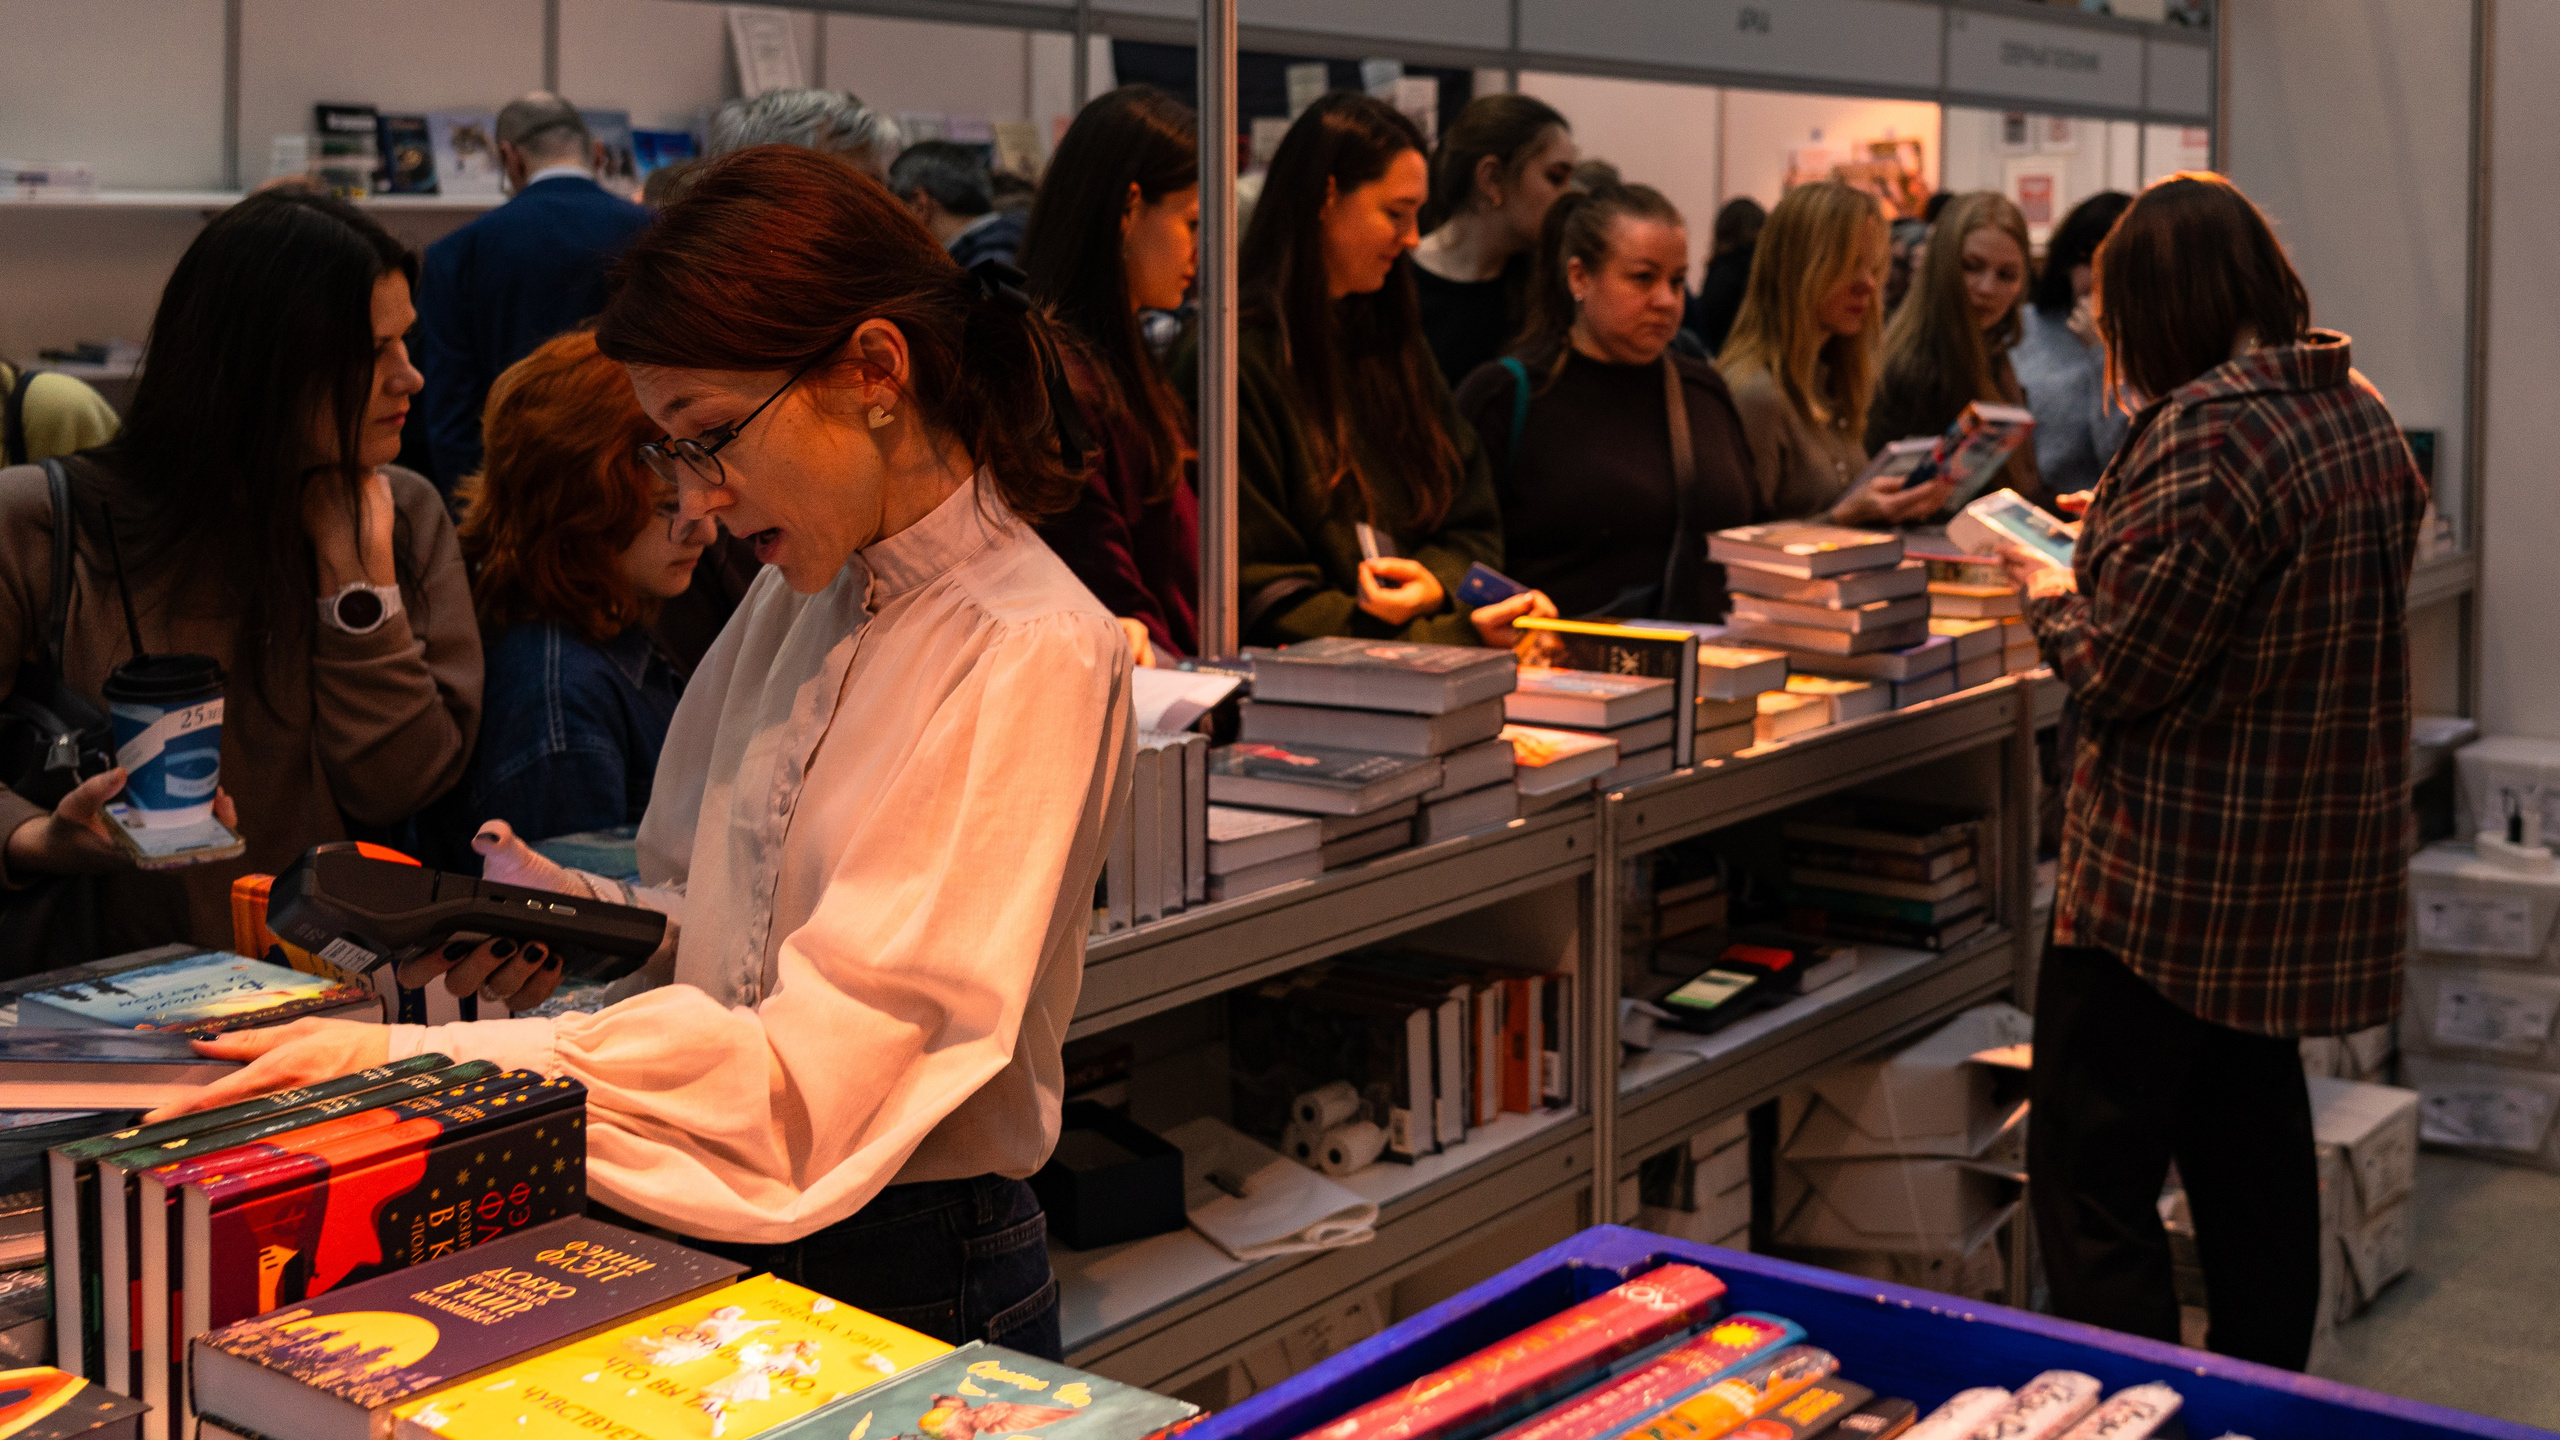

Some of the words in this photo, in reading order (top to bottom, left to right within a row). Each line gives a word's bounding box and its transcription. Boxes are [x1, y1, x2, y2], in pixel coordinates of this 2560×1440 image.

[180, 705, 204, 729] 25
[429, 1204, 456, 1228] В
[476, 1191, 505, 1245] ФЛ
[508, 1182, 531, 1227] ФЭ
[458, 1199, 472, 1249] ВОЗВР
[429, 1237, 456, 1260] К
[565, 1241, 657, 1273] ФЭННИ
[480, 1266, 577, 1299] ДОБРО
[535, 1250, 634, 1283] ФЛЭГГ
[433, 1279, 467, 1295] В
[604, 1356, 650, 1381] ЧТО
[646, 1377, 689, 1399] ВЫ
